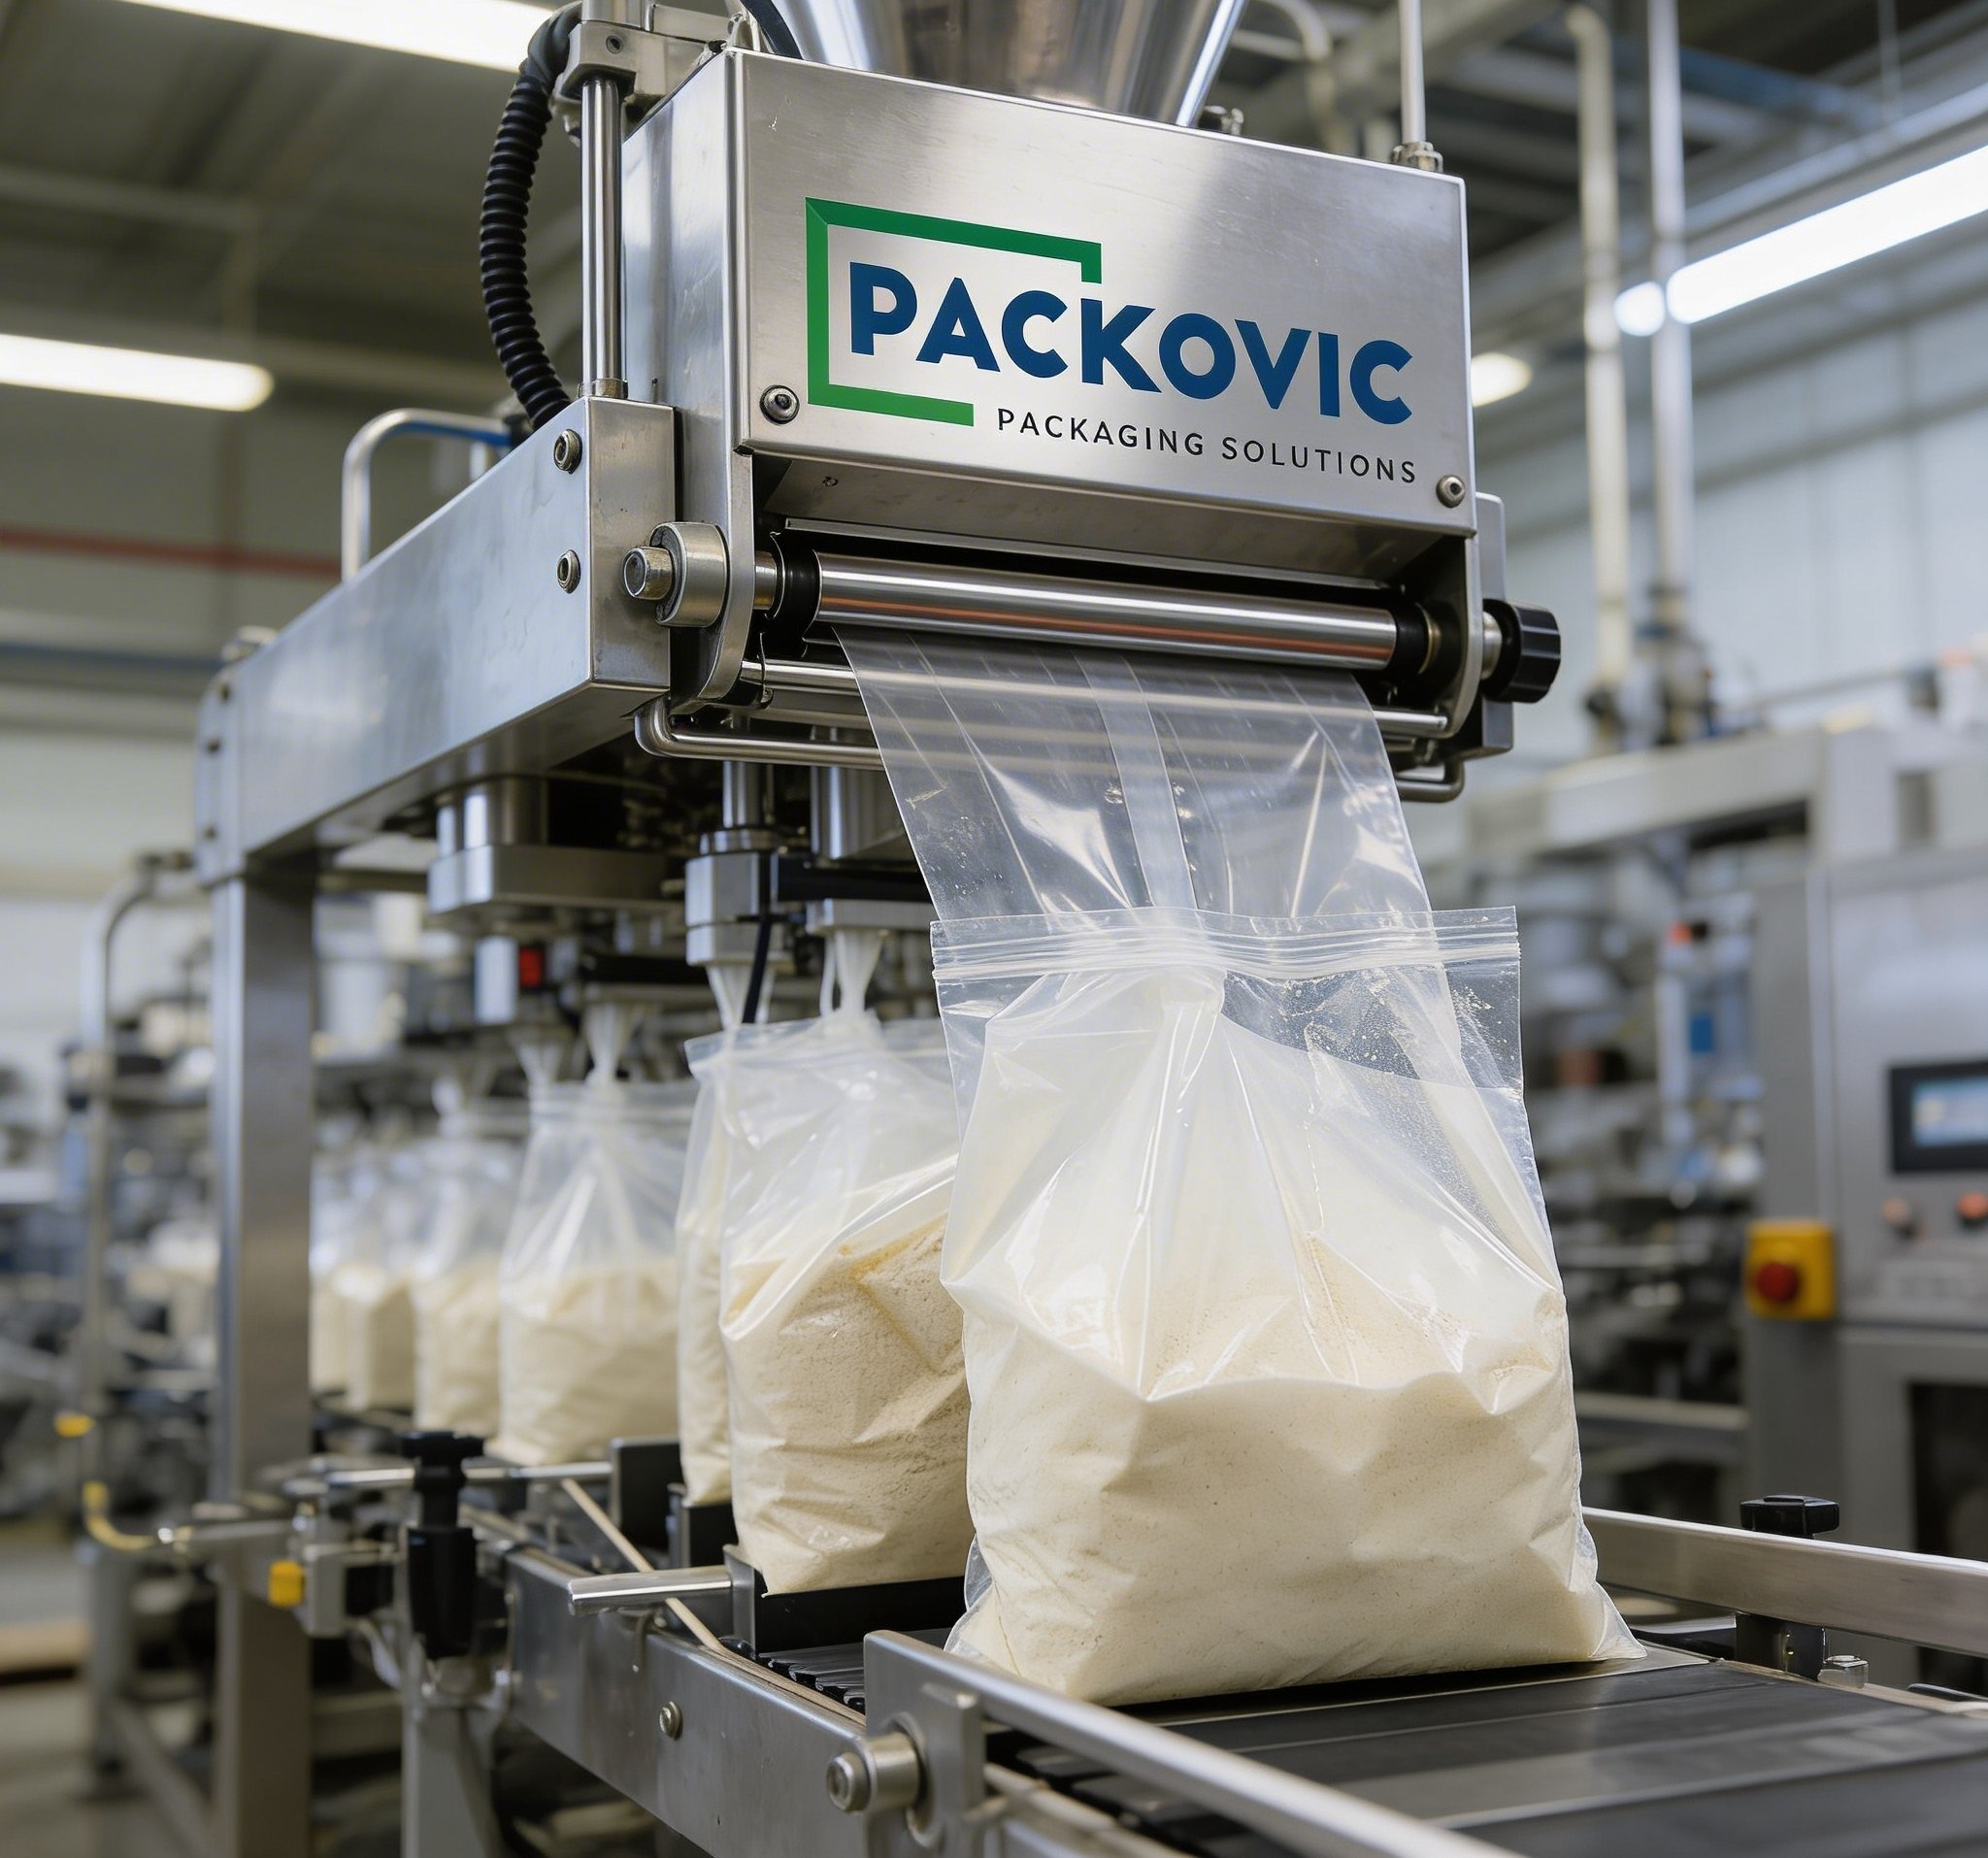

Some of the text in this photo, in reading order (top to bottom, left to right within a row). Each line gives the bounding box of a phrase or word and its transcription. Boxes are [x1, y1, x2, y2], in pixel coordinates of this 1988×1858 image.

[849, 261, 1413, 425] PACKOVIC
[998, 408, 1415, 483] PACKAGING SOLUTIONS
